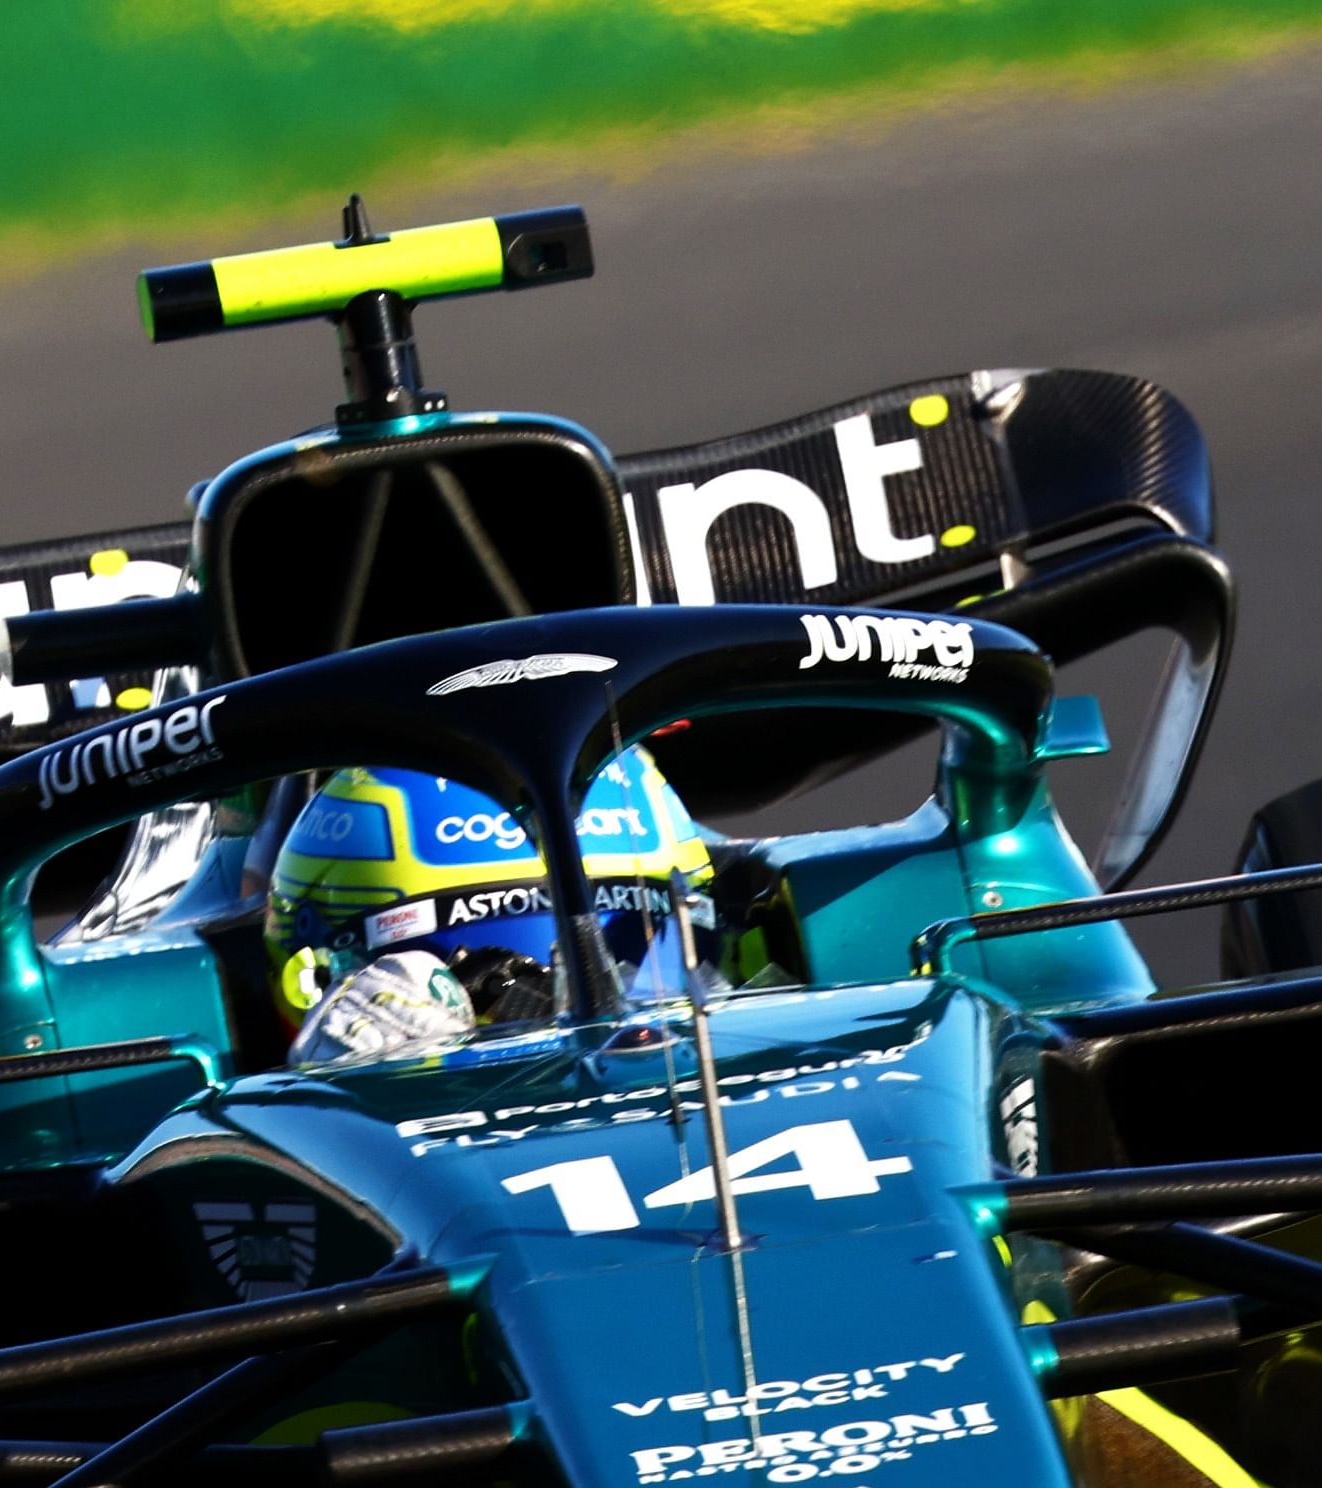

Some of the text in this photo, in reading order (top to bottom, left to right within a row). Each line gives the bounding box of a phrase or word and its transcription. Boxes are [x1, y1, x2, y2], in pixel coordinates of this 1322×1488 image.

[448, 885, 671, 926] ASTON ARTIN
[410, 1071, 923, 1157] FLY SAUDIA
[501, 1119, 913, 1237] 14
[612, 1352, 967, 1418] VELOCITY
[704, 1382, 890, 1422] BLACK
[629, 1402, 996, 1475] PERONI
[767, 1450, 913, 1483] 0.0%
